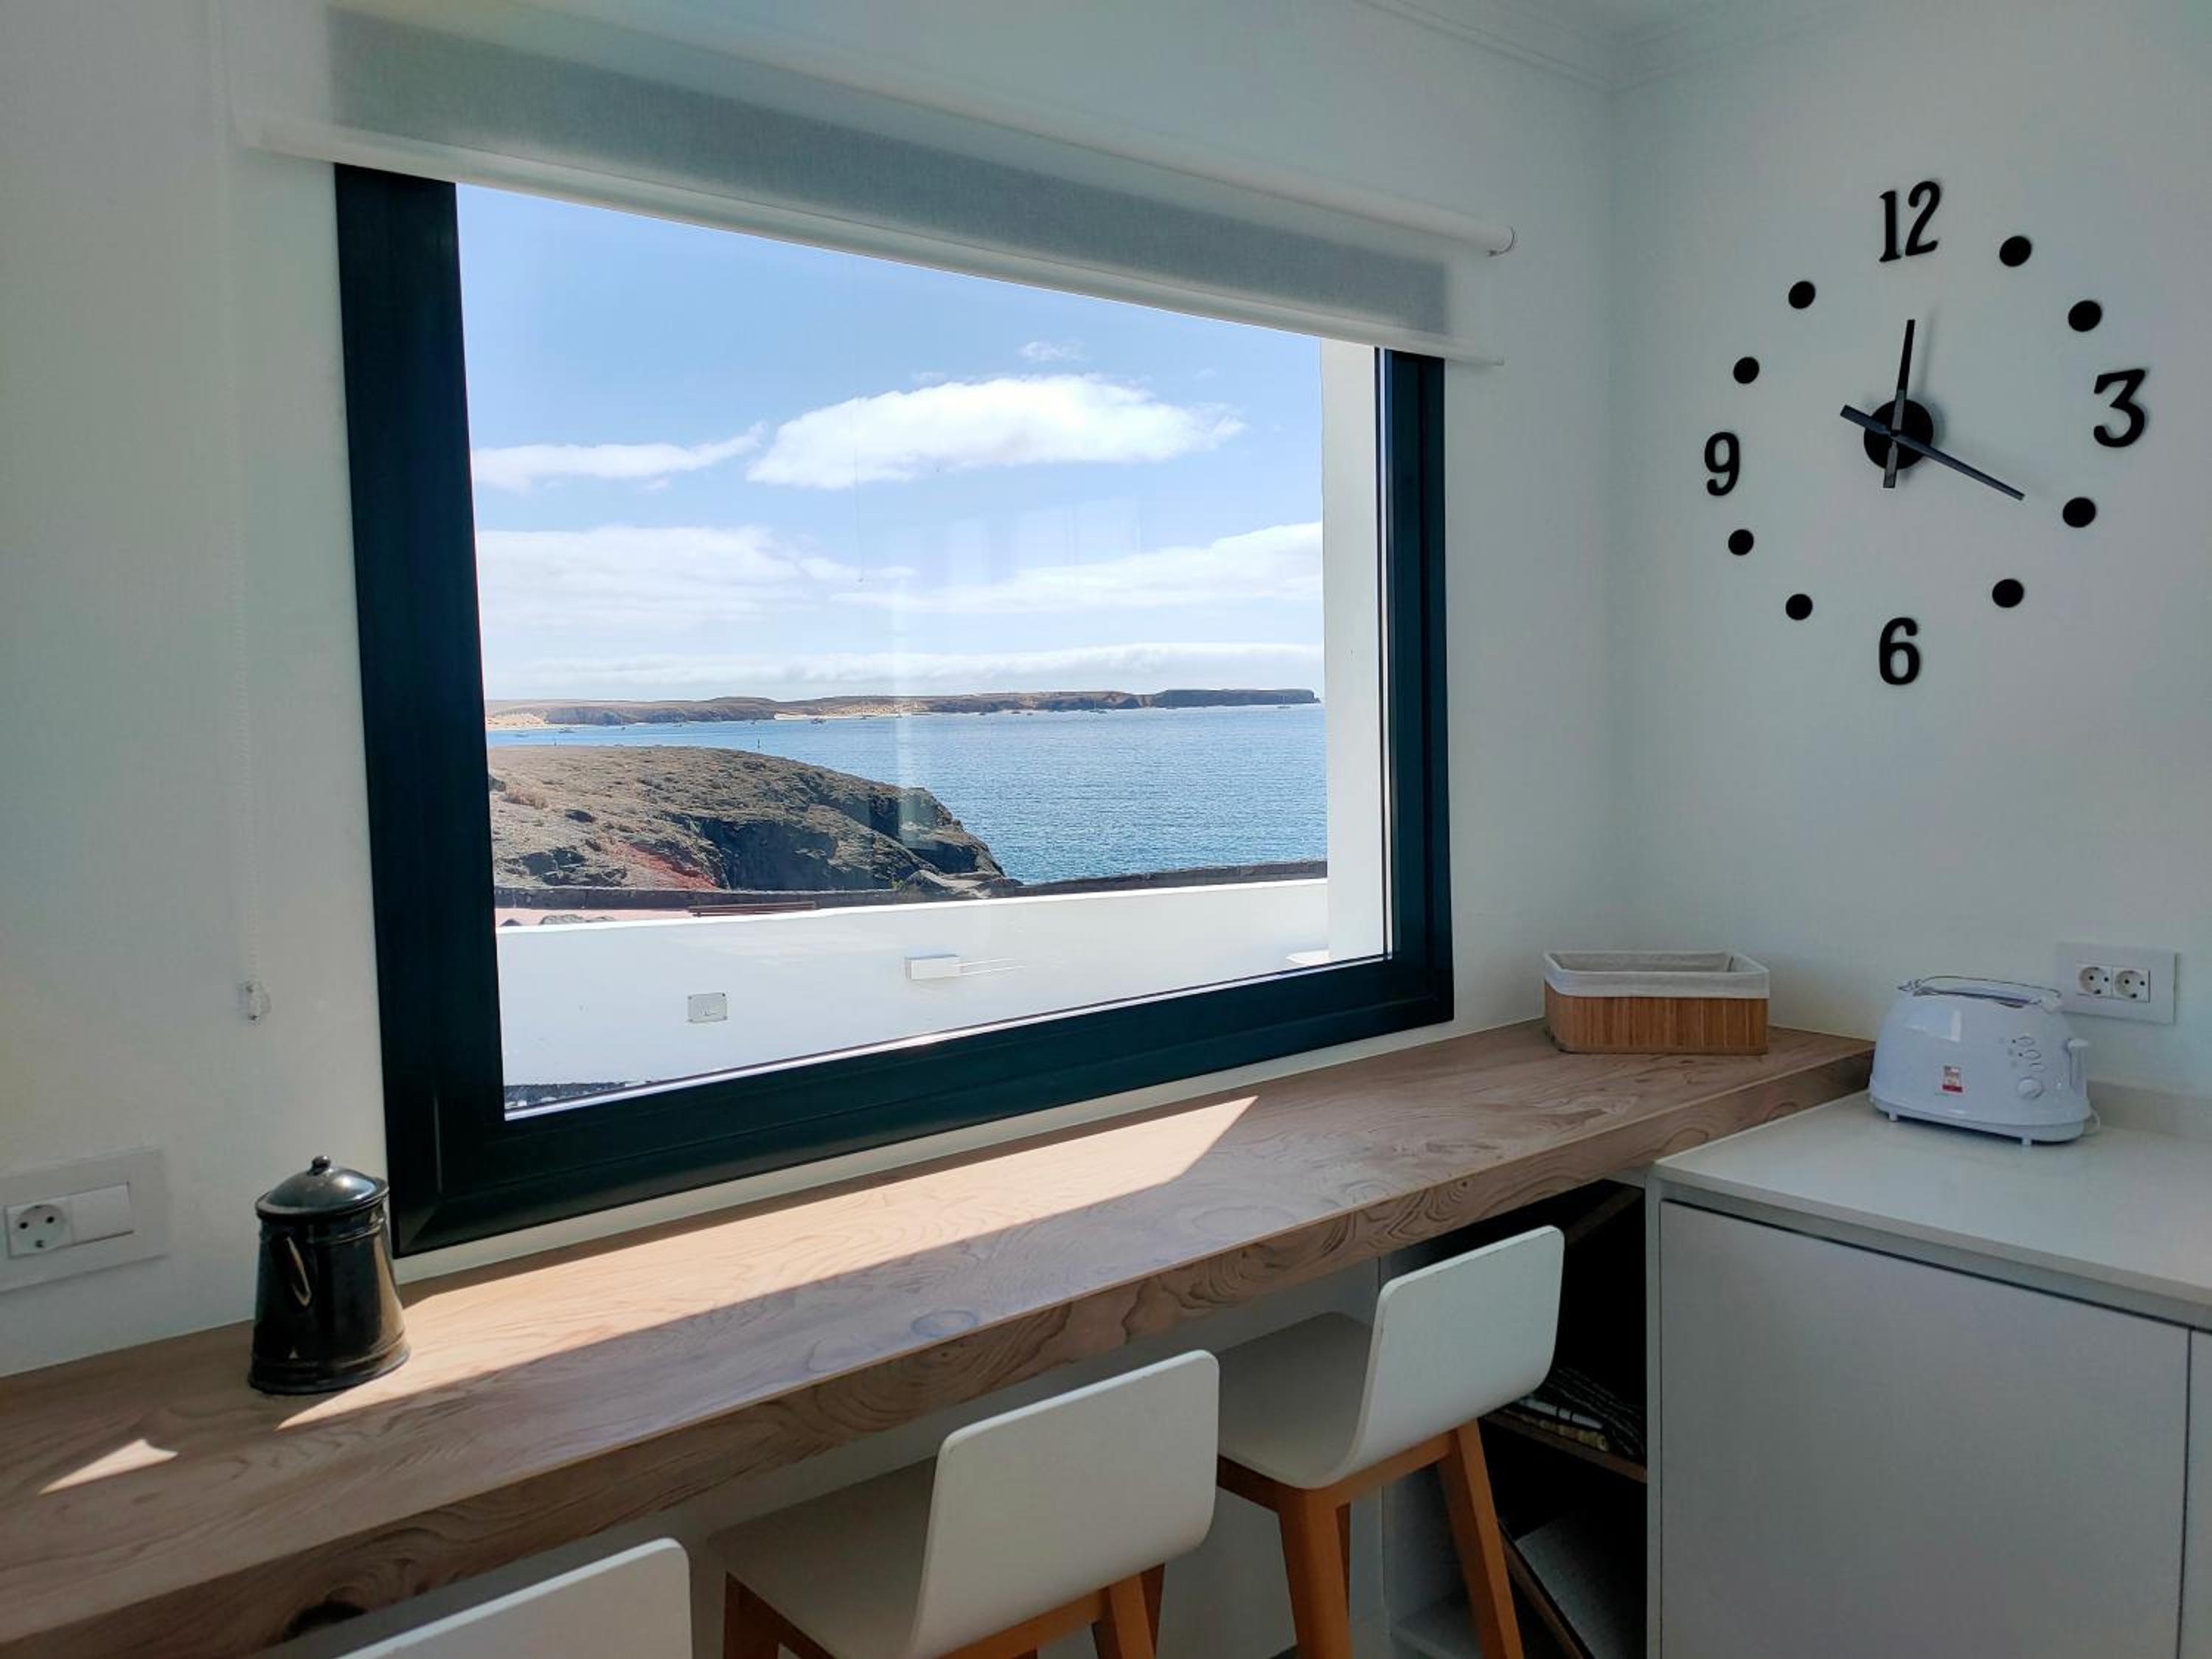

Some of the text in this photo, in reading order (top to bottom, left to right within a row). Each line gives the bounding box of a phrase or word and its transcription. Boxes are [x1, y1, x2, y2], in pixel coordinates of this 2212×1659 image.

[1879, 181, 1941, 263] 12
[2093, 368, 2146, 448] 3
[1704, 431, 1740, 497] 9
[1879, 617, 1921, 686] 6
